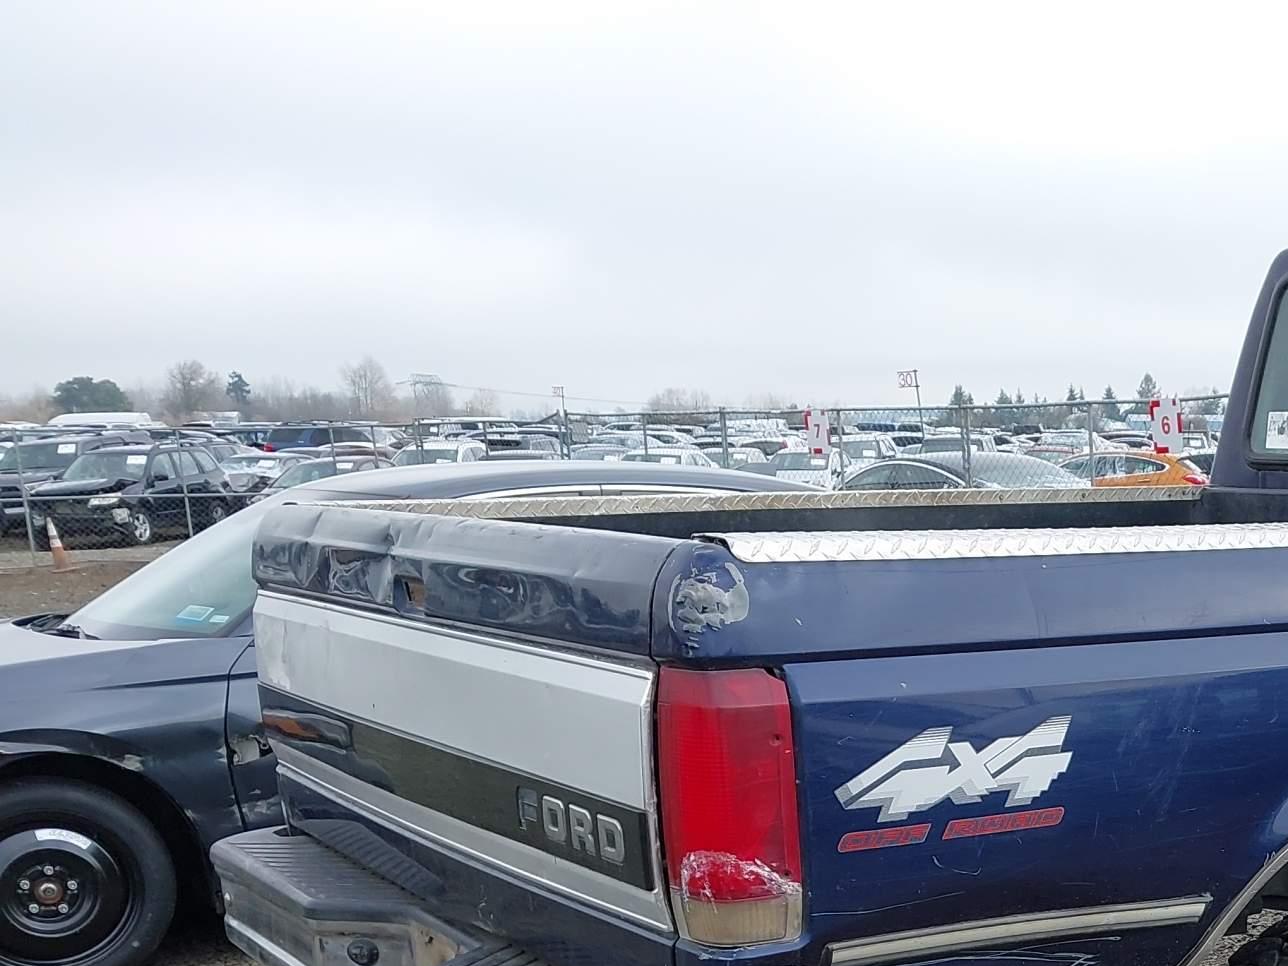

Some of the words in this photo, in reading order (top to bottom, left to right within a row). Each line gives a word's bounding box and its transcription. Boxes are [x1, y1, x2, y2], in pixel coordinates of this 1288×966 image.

[898, 373, 913, 388] 30
[813, 423, 820, 439] 7
[1161, 415, 1171, 435] 6
[515, 785, 626, 865] FORD
